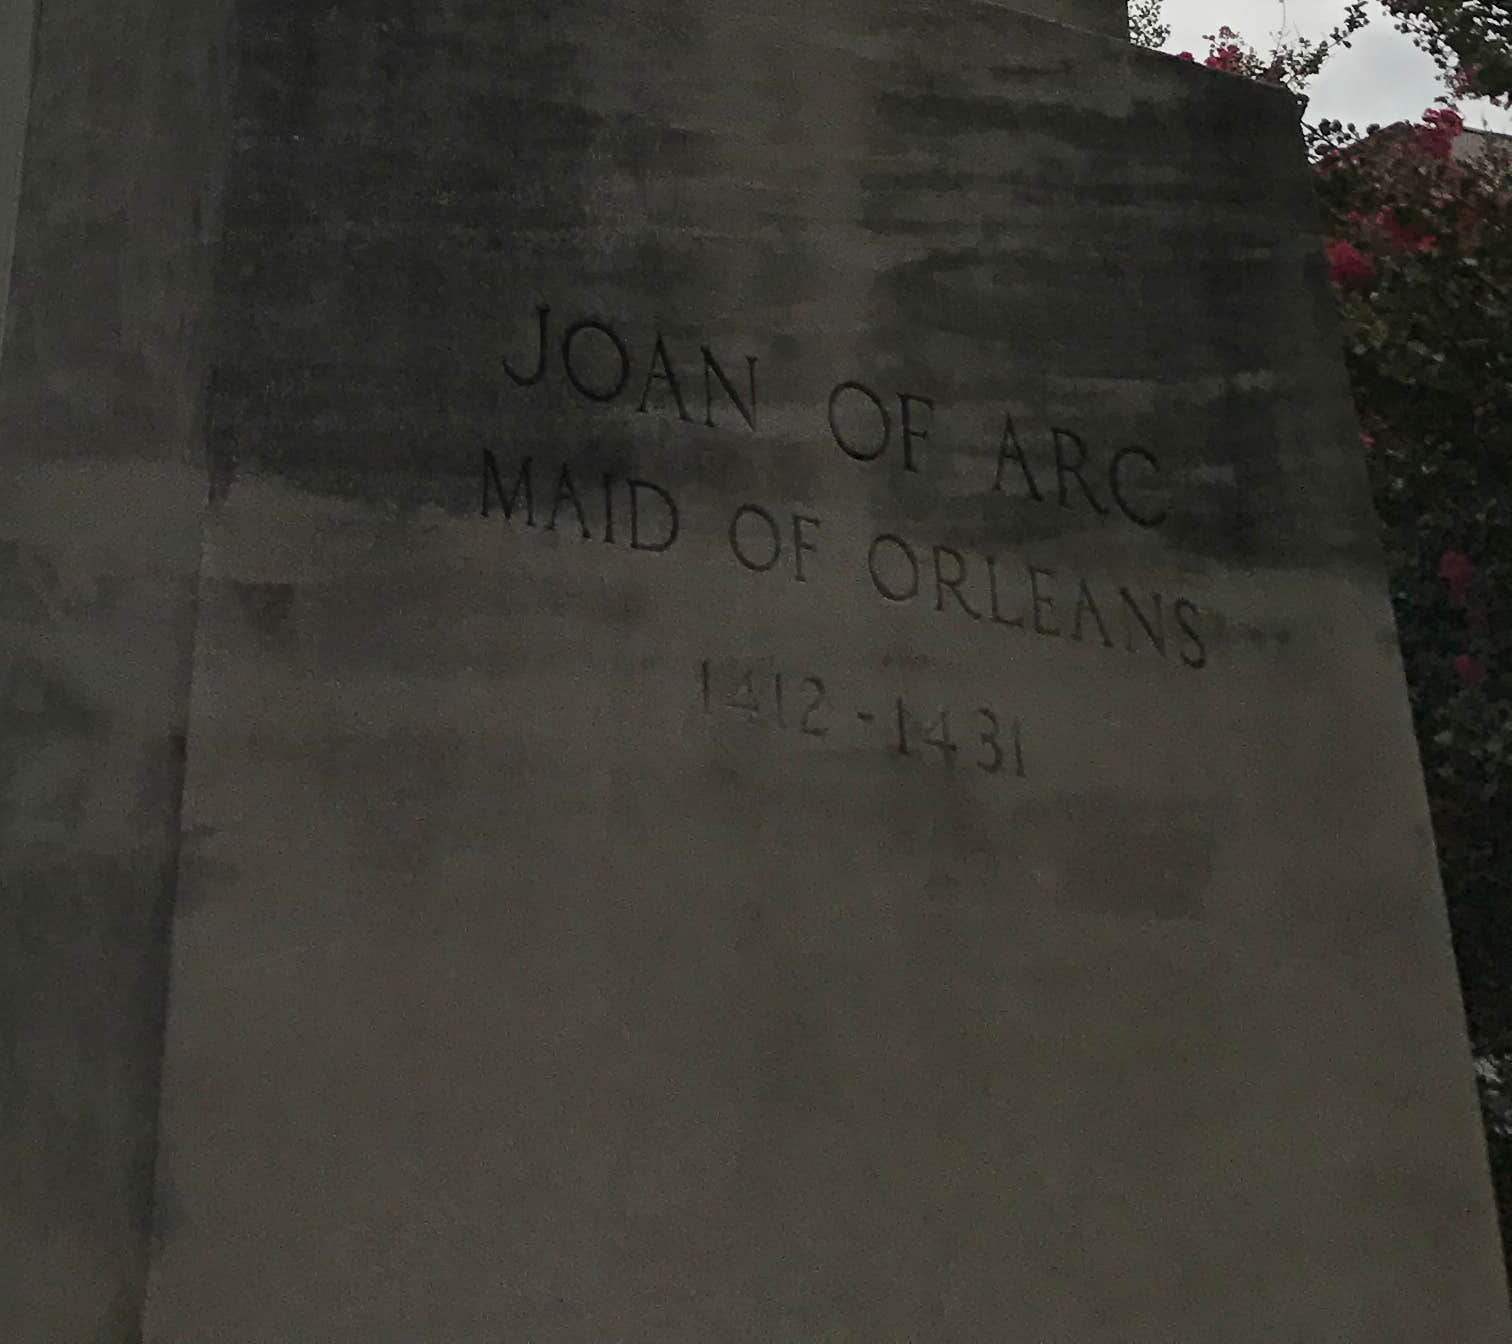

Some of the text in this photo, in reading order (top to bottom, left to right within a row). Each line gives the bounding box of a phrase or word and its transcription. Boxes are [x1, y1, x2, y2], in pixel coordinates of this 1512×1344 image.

[501, 302, 1170, 527] JOAN OF ARC
[478, 448, 1209, 670] MAID OF ORLEANS
